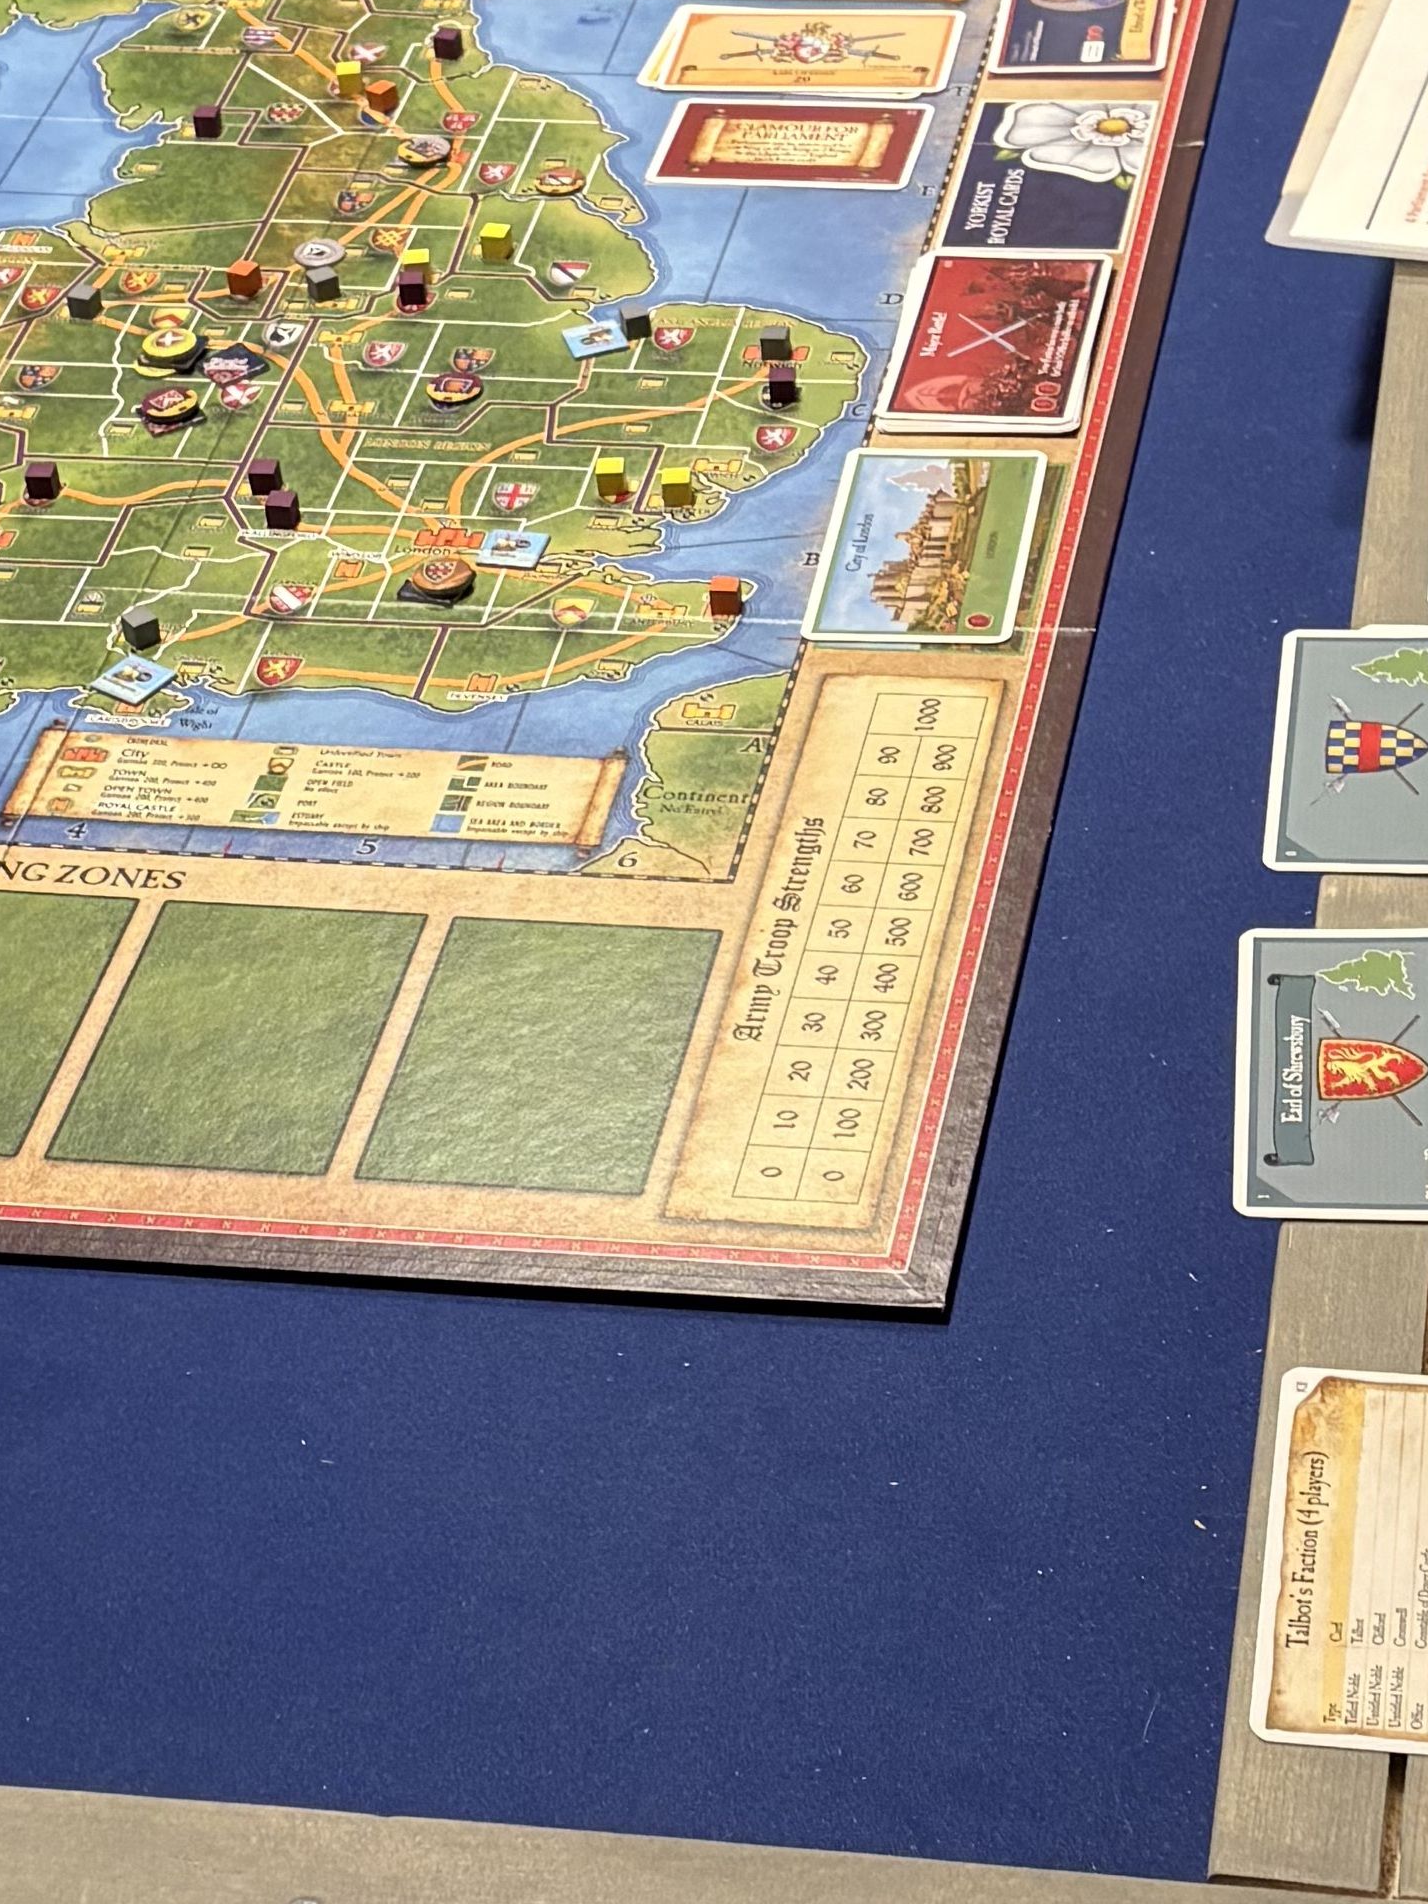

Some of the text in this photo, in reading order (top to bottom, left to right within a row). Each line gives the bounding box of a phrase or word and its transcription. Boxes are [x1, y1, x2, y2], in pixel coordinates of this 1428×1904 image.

[964, 181, 996, 231] YORKIST
[987, 168, 1025, 245] ROYAL CARDS
[852, 514, 875, 542] London
[845, 554, 868, 572] City
[915, 697, 942, 734] 1000
[741, 735, 765, 754] A
[642, 784, 750, 804] Continent
[65, 821, 88, 841] 4
[356, 839, 379, 855] 5
[615, 849, 639, 869] 6
[55, 864, 187, 891] ZONES
[733, 814, 825, 1043] Army Troop Strengths
[762, 745, 901, 1178] 0 10 20 30 40 50 60 70 80 90
[823, 743, 957, 1182] 0 100 200 300 400 500 600 700 800 900
[1282, 1014, 1311, 1123] Earl of Shrewsbury
[1286, 1451, 1330, 1648] Talbot's Faction (4 players)
